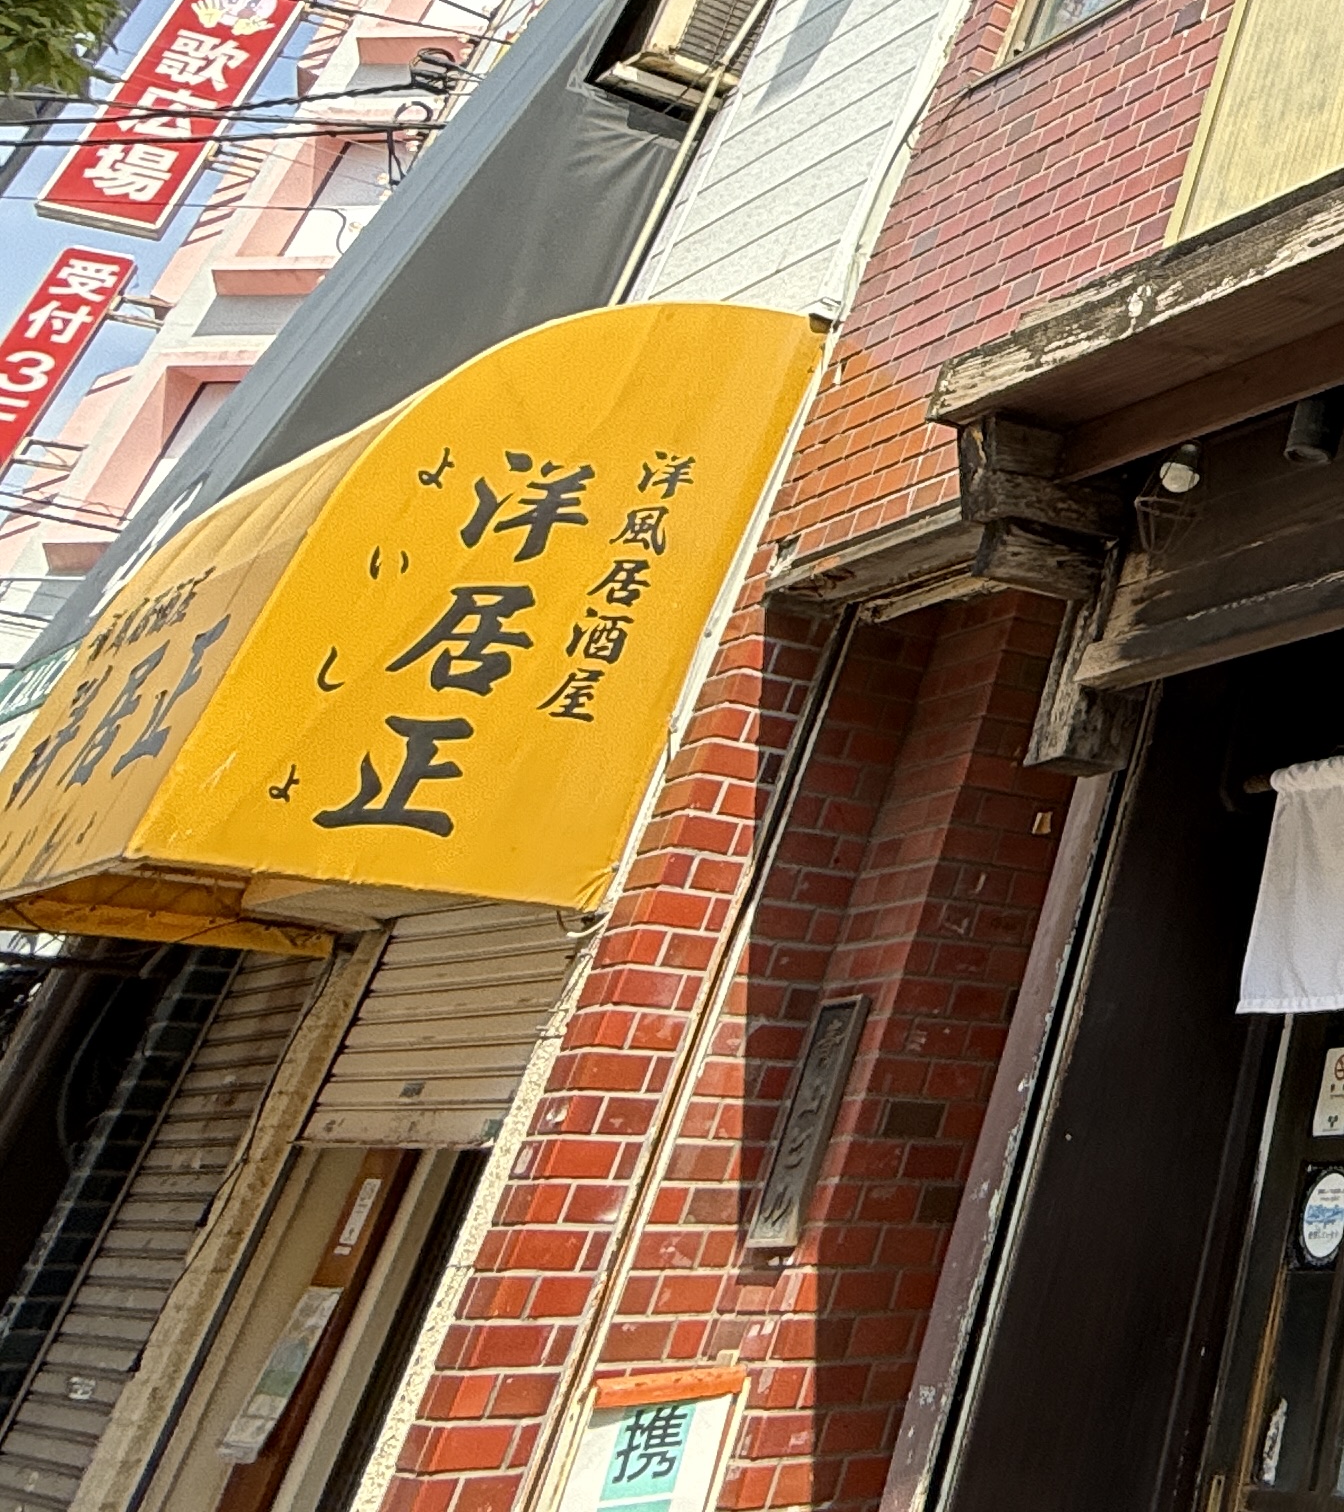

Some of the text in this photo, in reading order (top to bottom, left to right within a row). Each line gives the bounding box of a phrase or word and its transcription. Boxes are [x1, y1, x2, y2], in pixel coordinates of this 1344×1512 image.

[83, 28, 250, 202] 歌広場
[311, 450, 595, 838] 洋居正
[536, 450, 697, 724] 洋風居酒屋
[612, 1407, 685, 1483] 携
